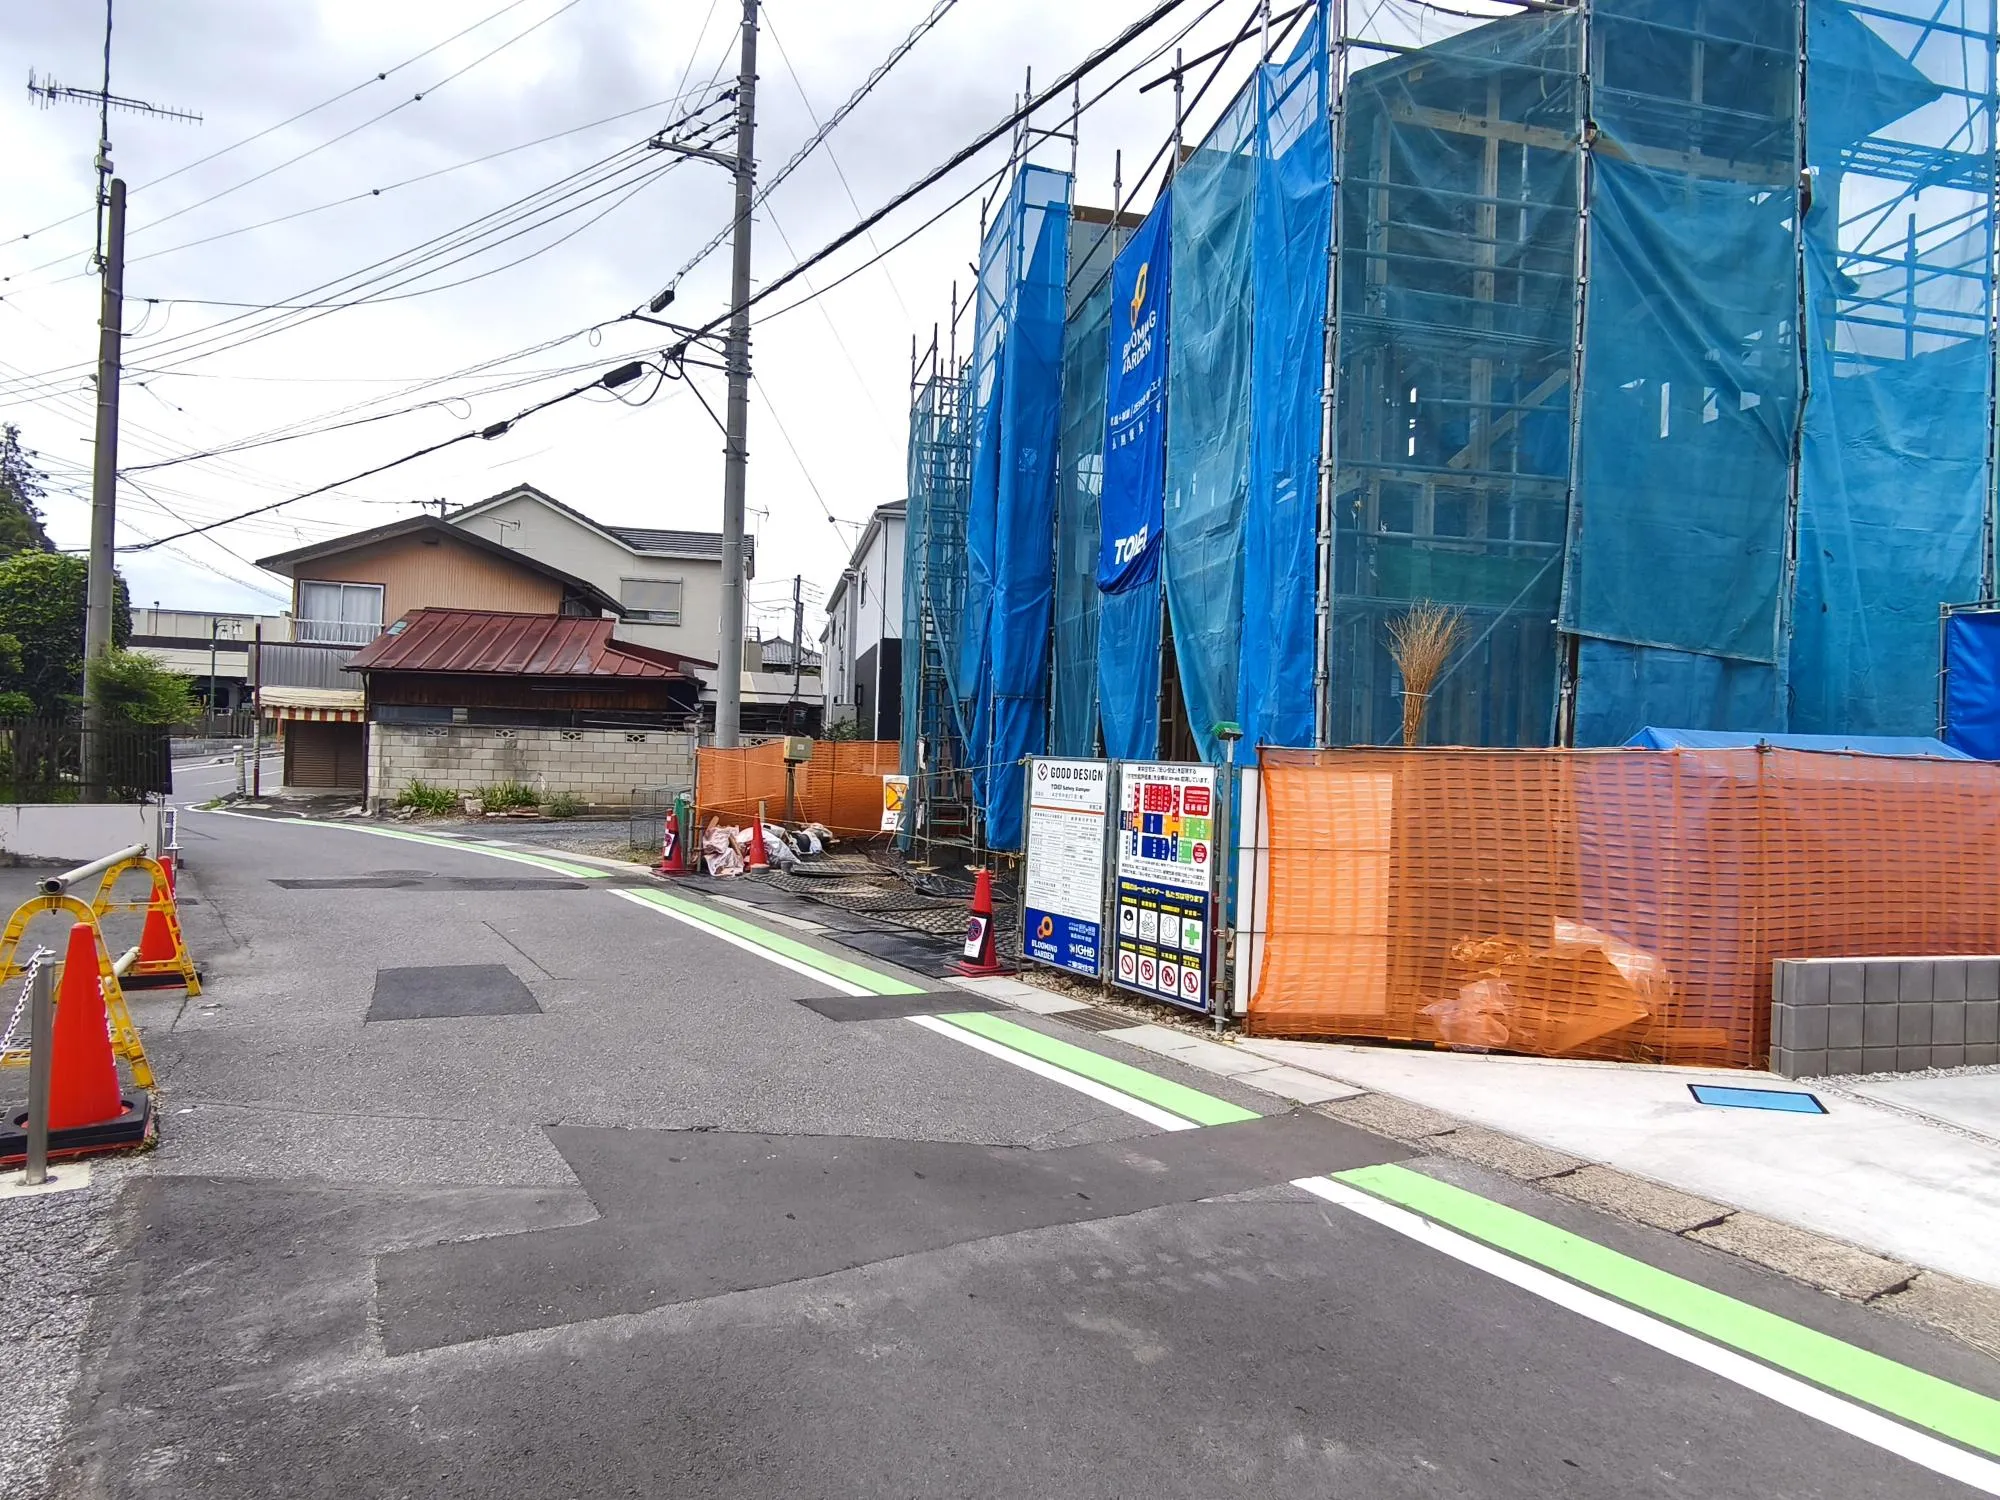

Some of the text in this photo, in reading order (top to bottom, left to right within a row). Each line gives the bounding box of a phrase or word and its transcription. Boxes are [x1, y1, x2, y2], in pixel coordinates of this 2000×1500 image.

[1050, 767, 1104, 781] GOOD DESIGN
[1033, 949, 1055, 961] GARDEN
